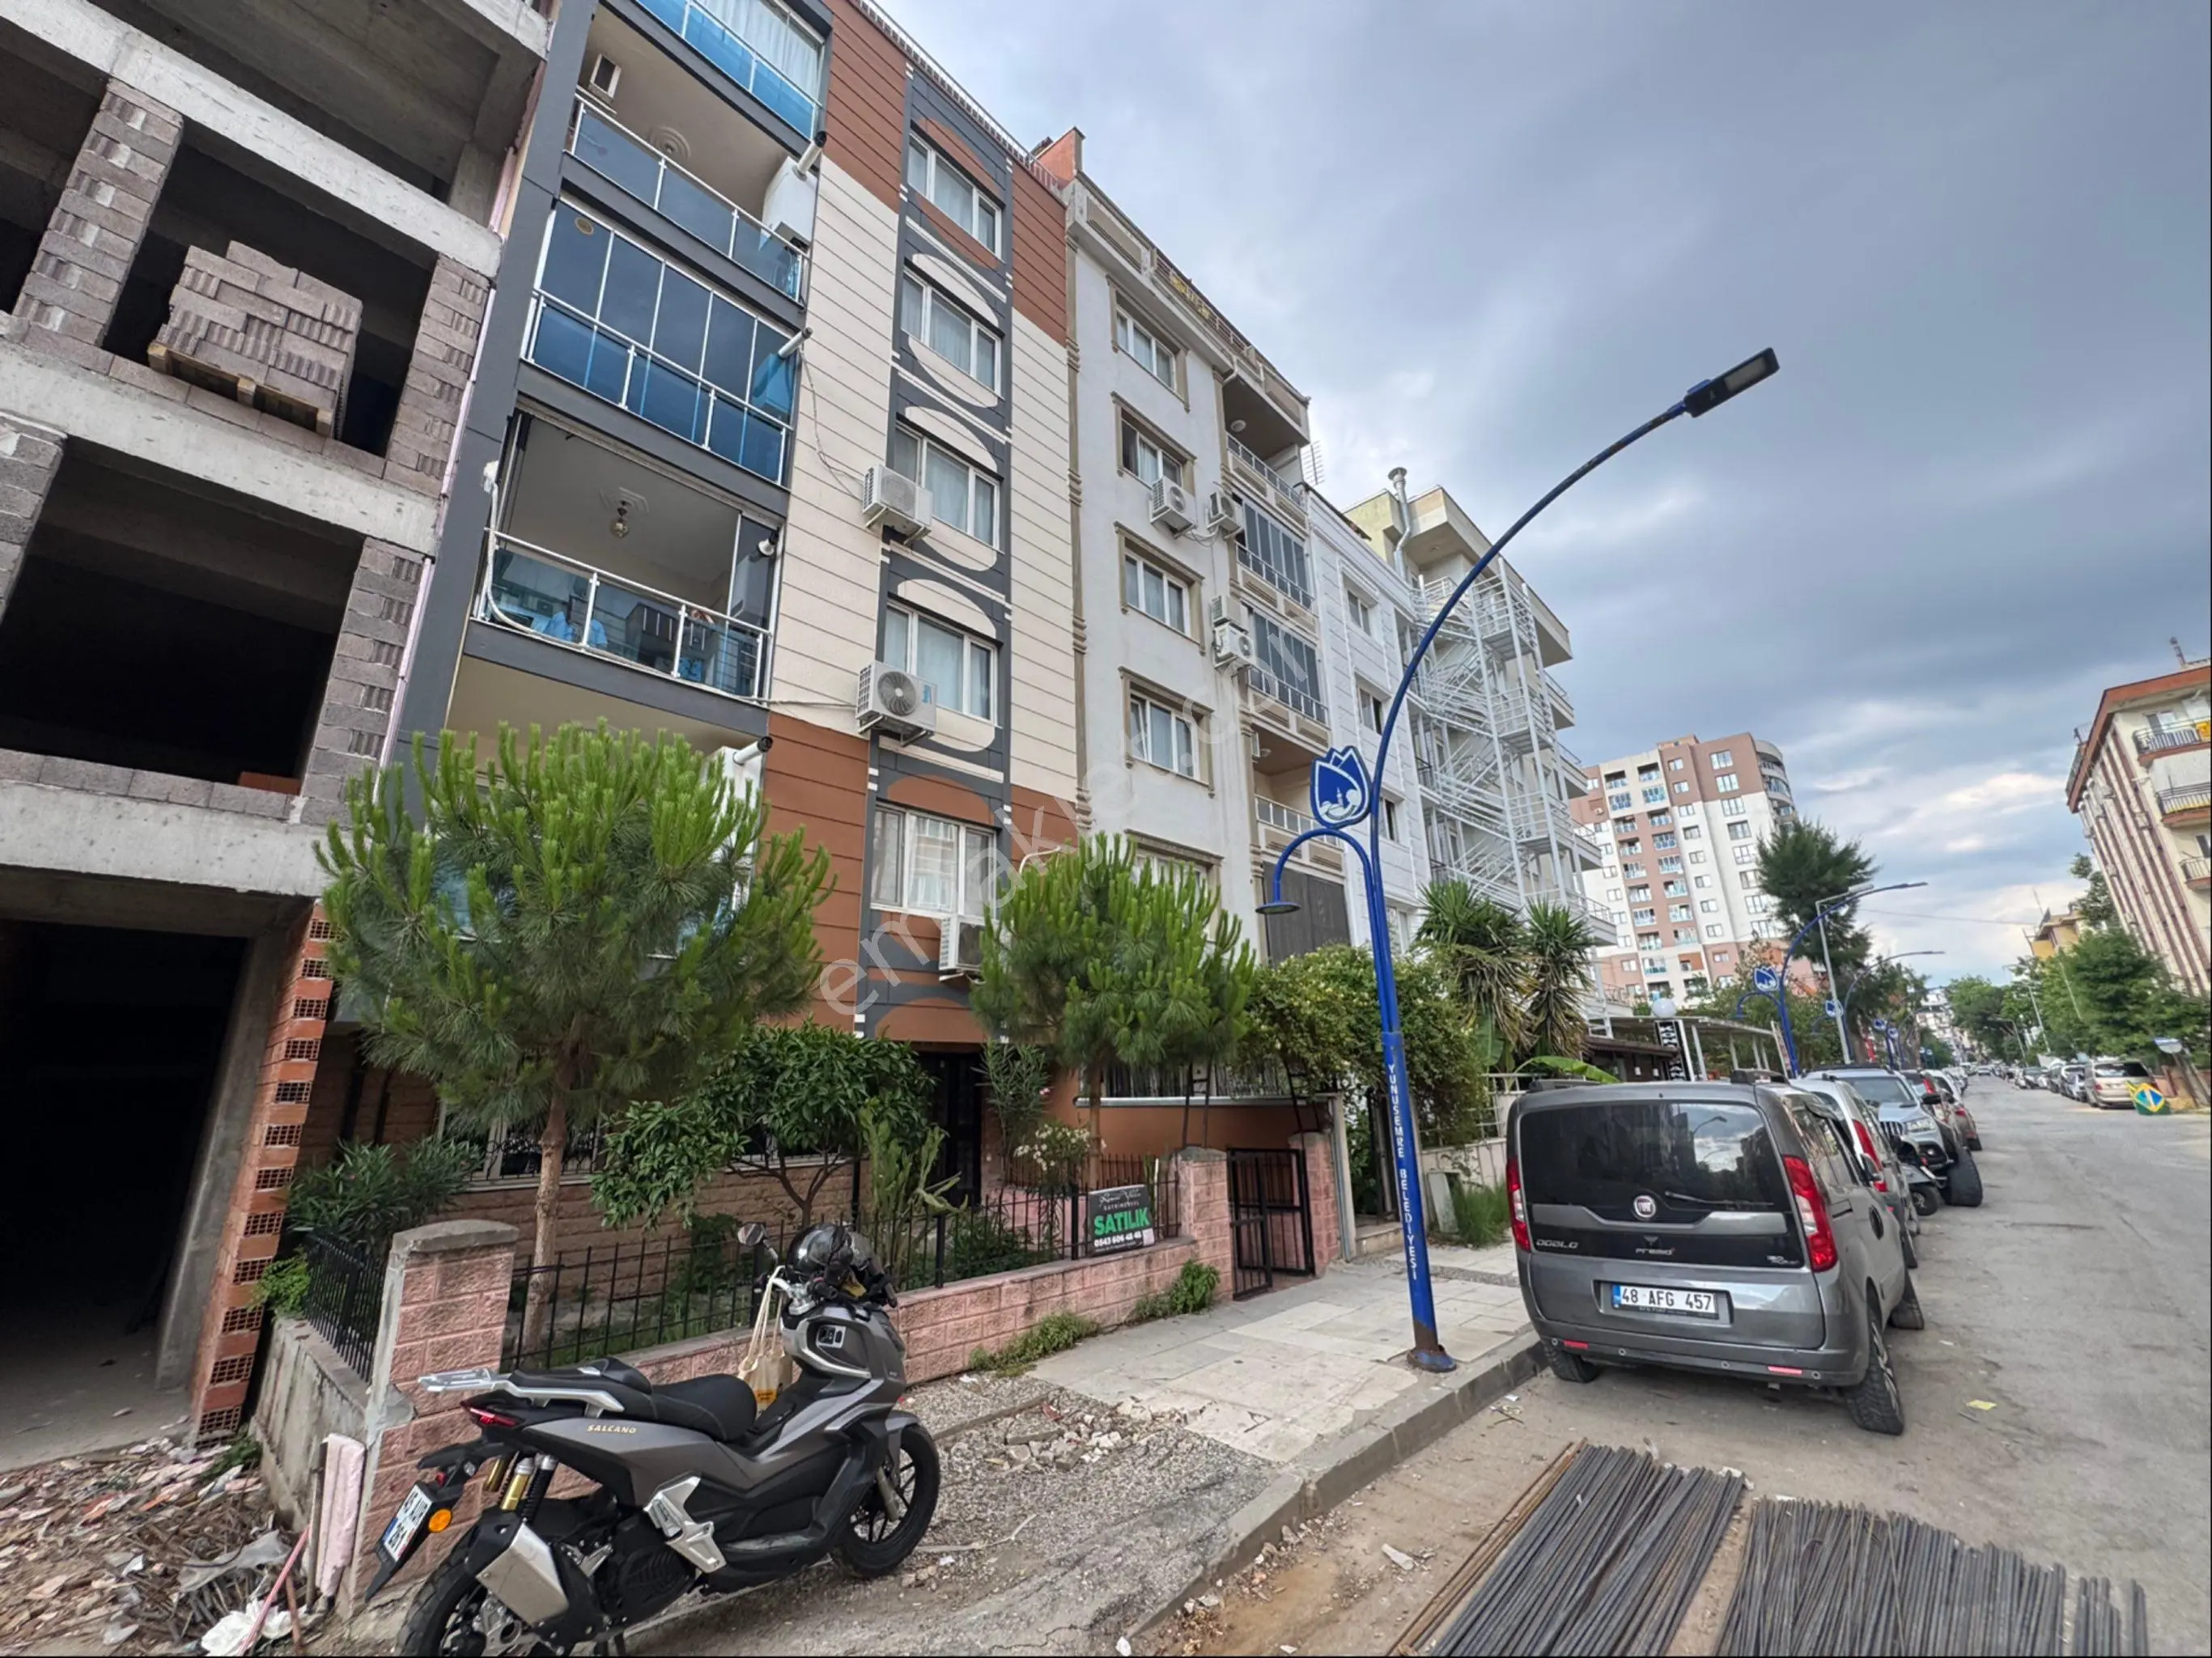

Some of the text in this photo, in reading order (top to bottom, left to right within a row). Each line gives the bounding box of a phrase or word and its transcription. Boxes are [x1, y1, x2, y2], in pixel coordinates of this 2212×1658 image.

[1388, 1063, 1404, 1158] YUNUSEMRE
[1094, 1207, 1150, 1236] SATILIK
[1536, 1239, 1579, 1249] DOBLO
[1622, 1287, 1712, 1310] 48 AFG 457
[587, 1424, 637, 1434] SALCANO
